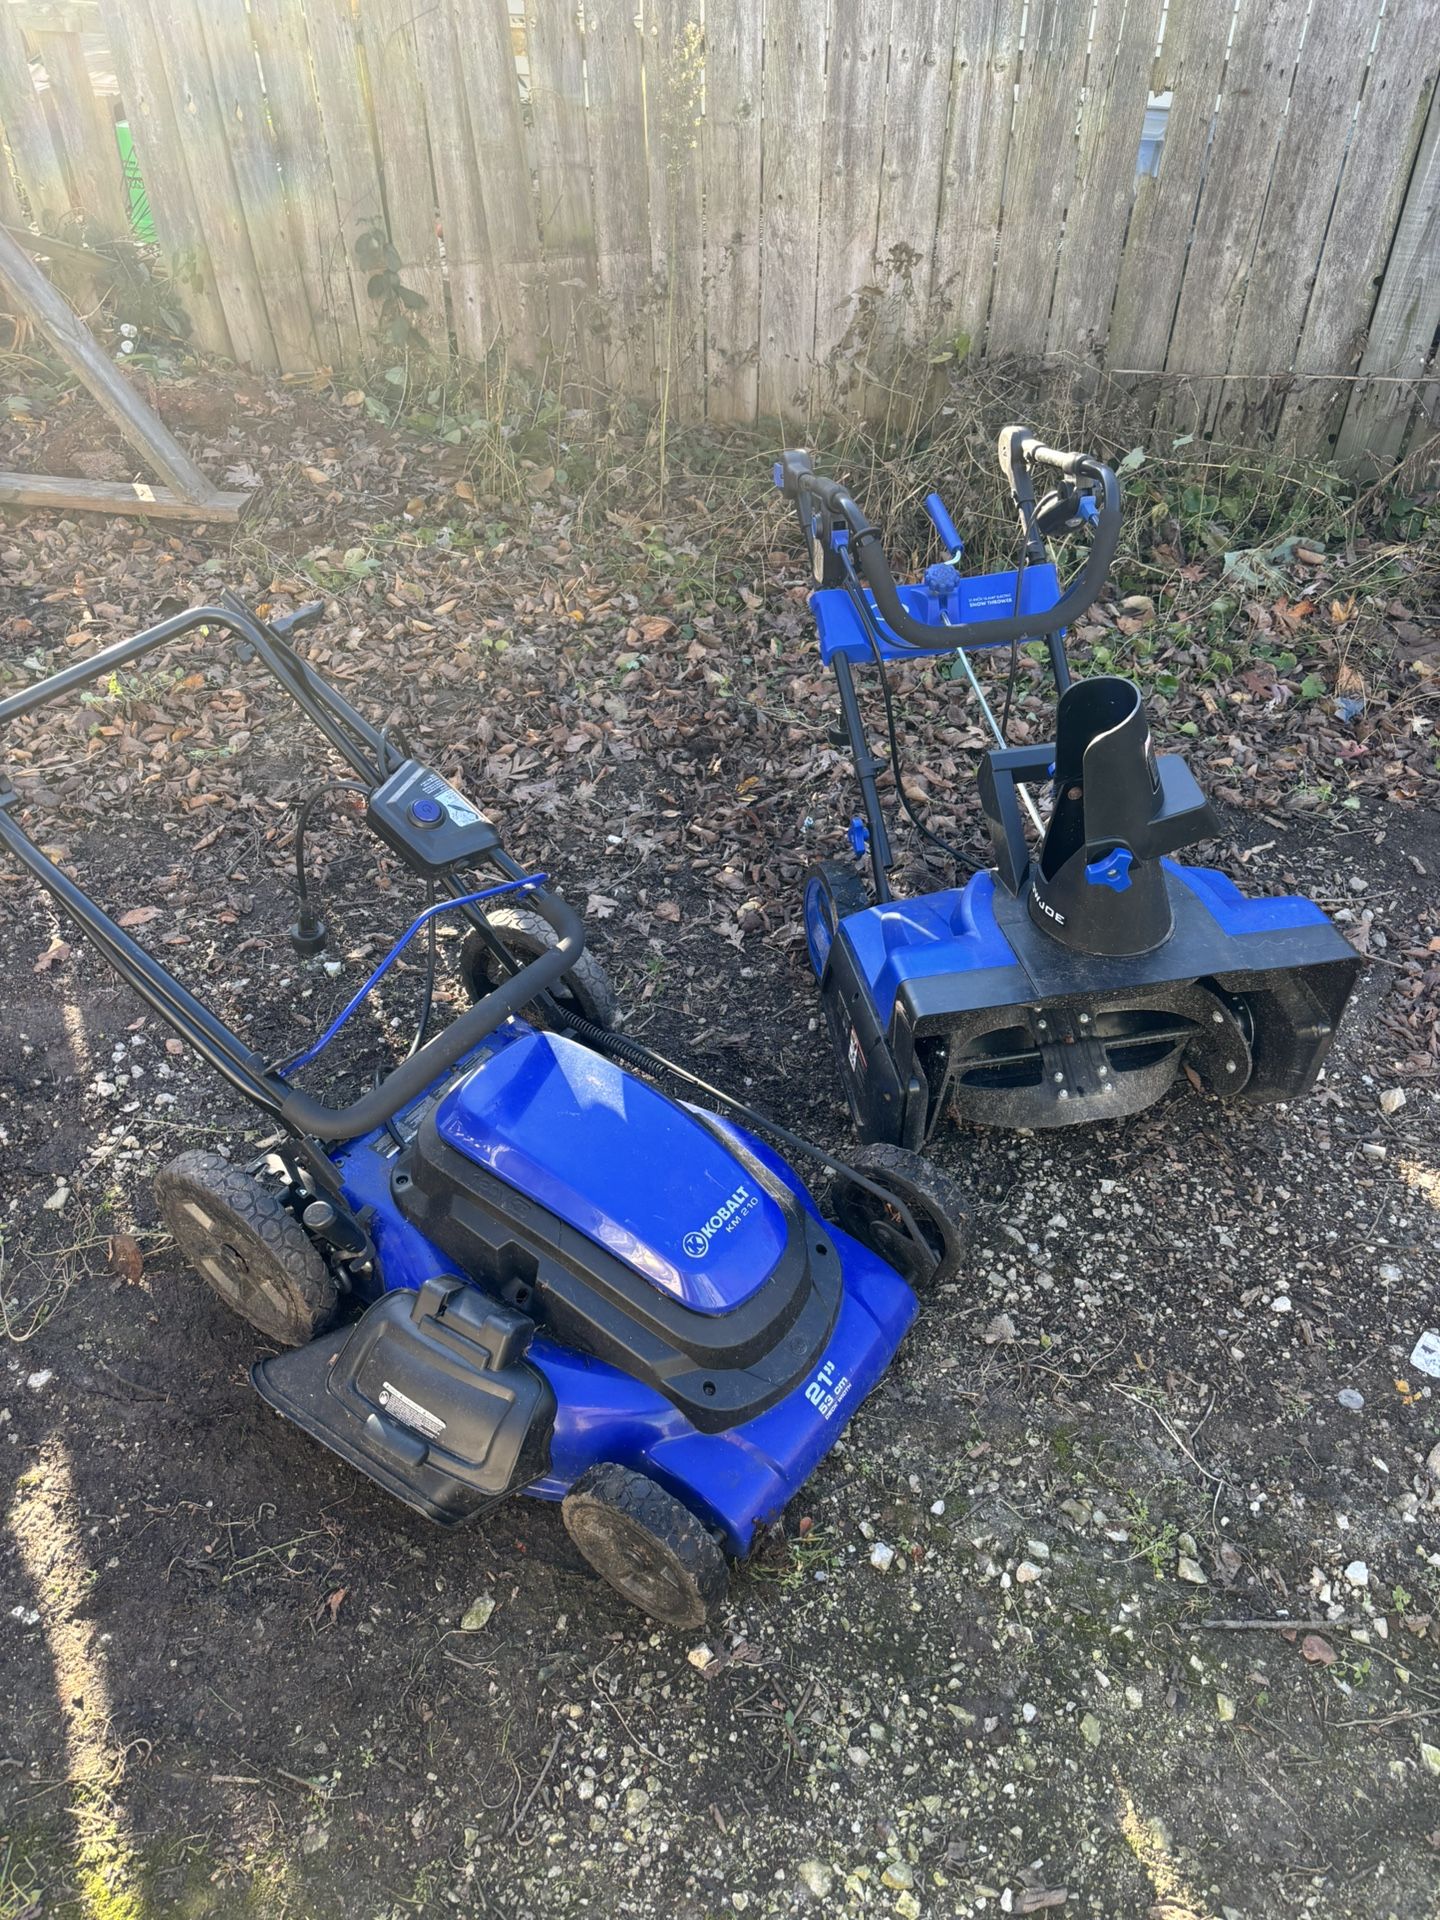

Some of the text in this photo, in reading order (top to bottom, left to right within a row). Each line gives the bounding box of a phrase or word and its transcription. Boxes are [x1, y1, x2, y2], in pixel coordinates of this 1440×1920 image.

[700, 1185, 750, 1239] KOBALT
[725, 1197, 759, 1233] KM 210
[818, 1376, 848, 1415] 53 cm
